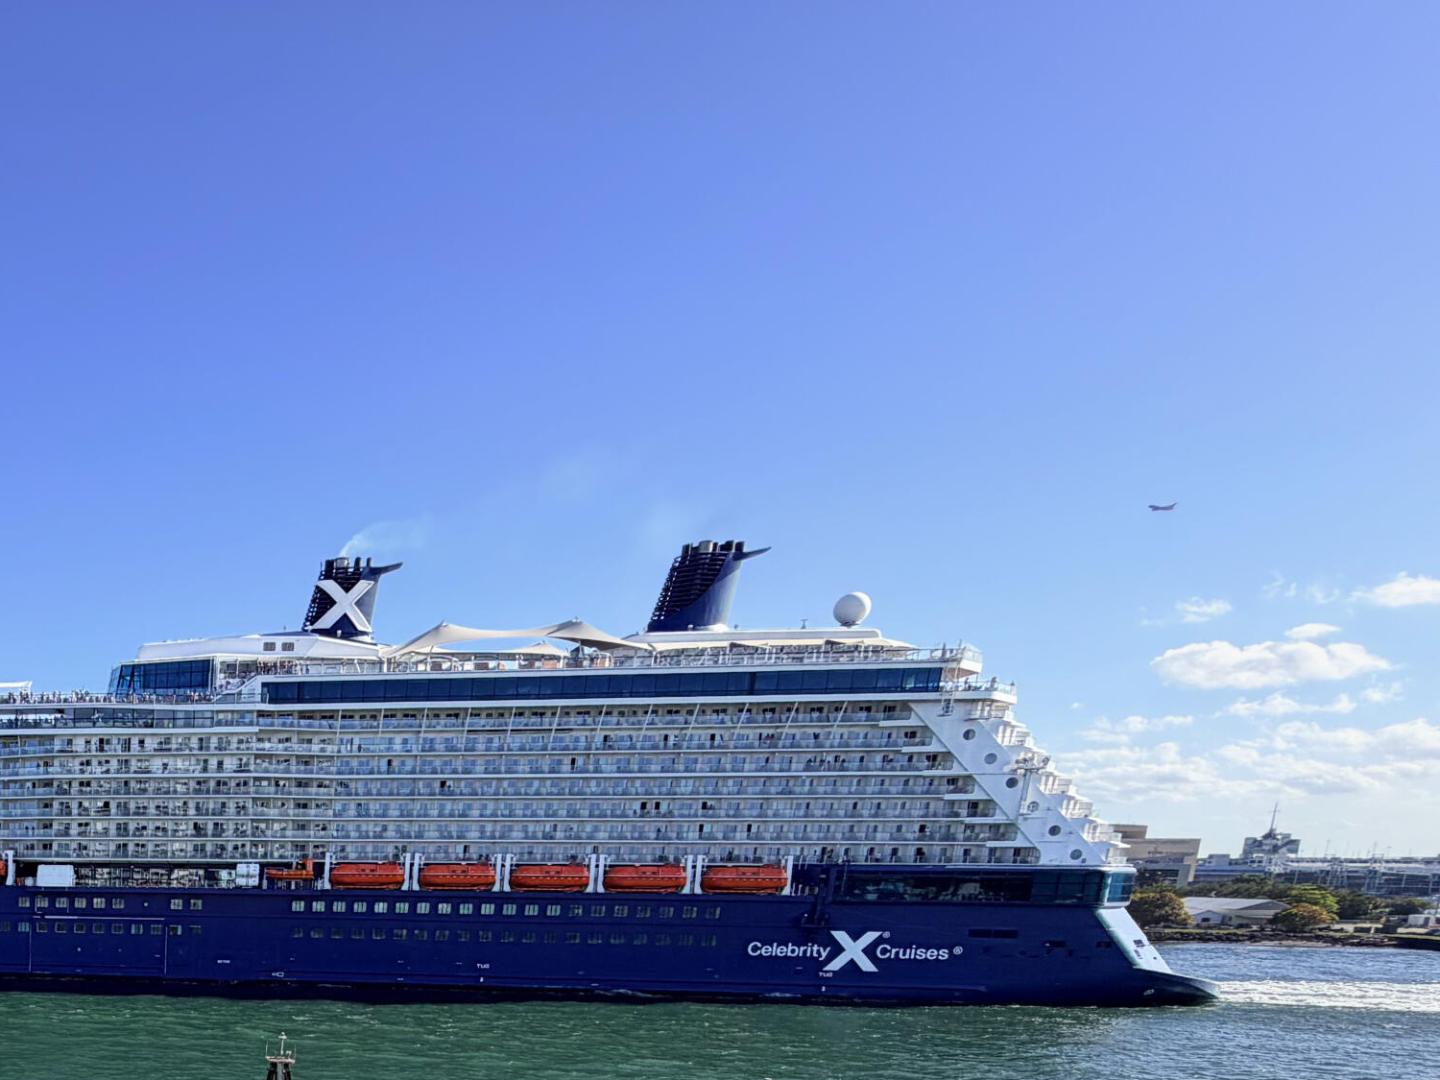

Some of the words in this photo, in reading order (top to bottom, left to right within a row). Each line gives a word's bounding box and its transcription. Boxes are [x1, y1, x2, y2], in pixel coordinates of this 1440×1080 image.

[747, 941, 831, 960] Celebrity
[822, 930, 883, 972] X
[876, 944, 949, 960] Cruises
